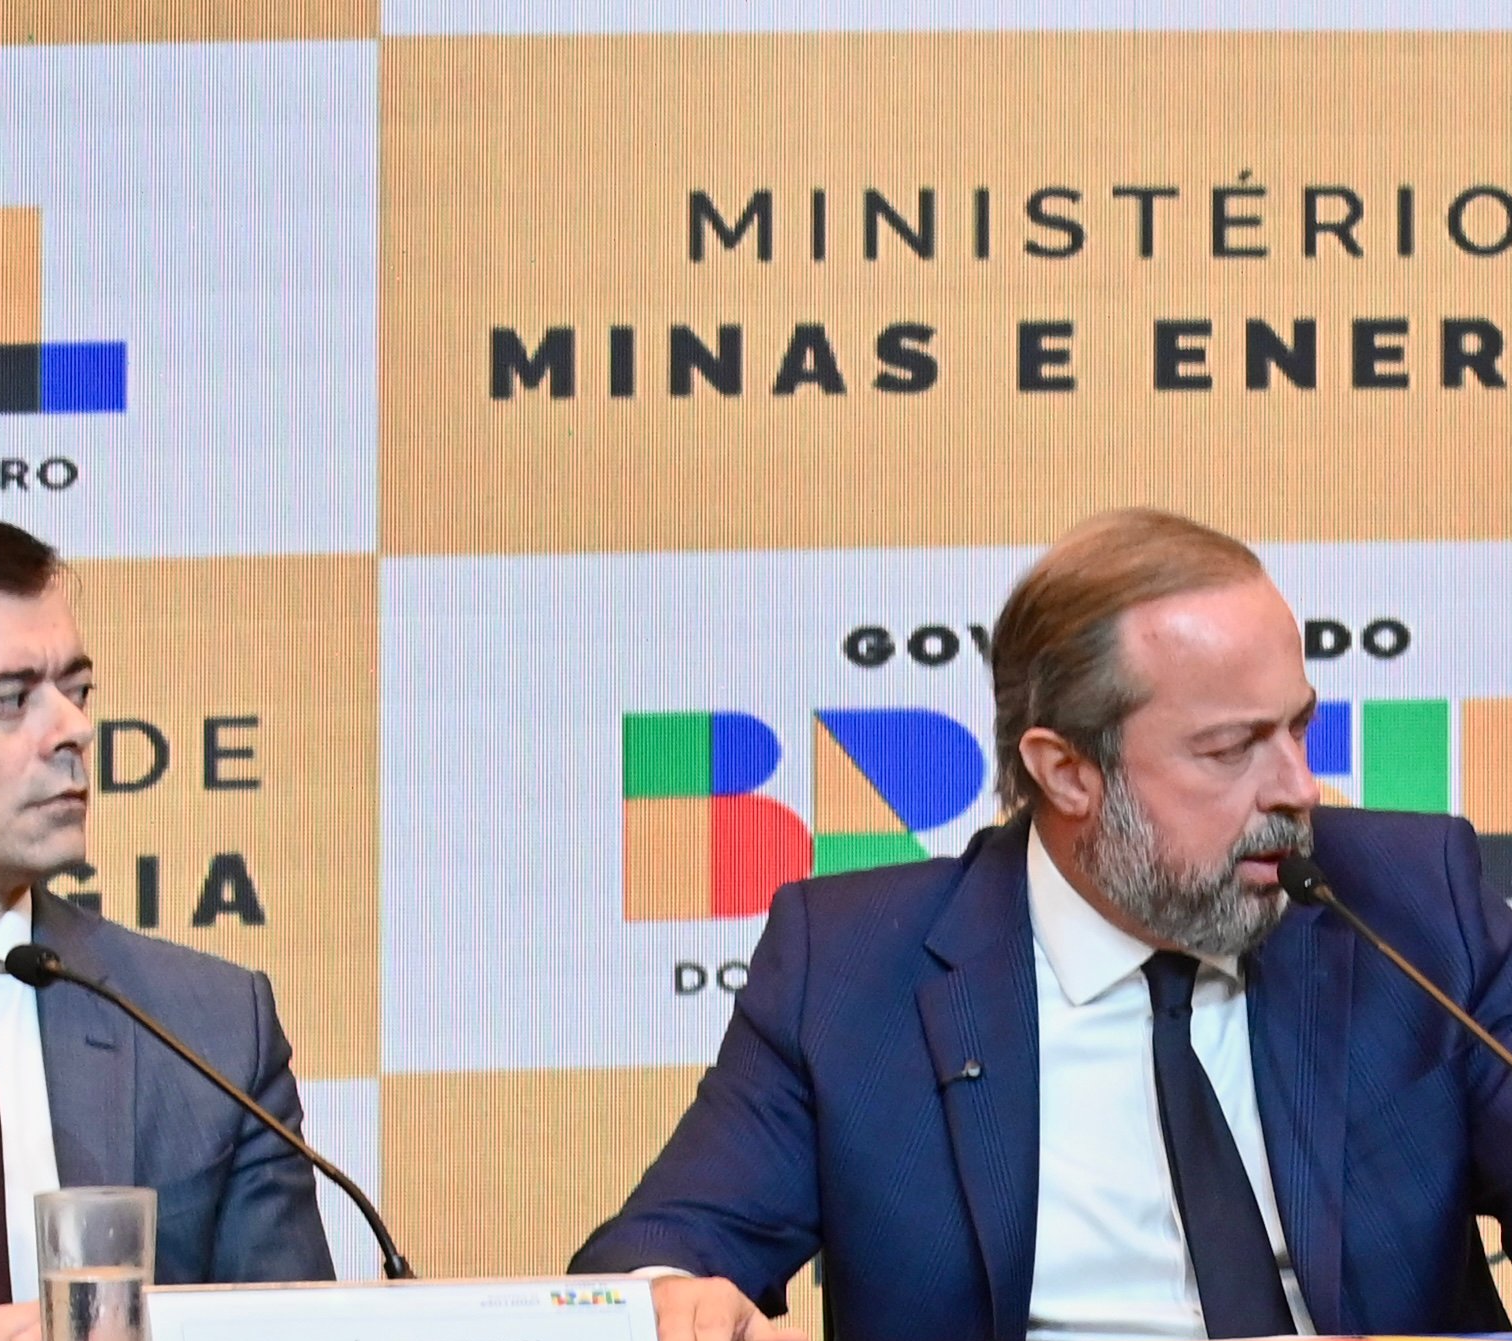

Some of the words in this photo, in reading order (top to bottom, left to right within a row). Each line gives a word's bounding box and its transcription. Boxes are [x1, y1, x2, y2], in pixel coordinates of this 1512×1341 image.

[489, 322, 938, 400] MINAS
[1017, 321, 1076, 393] E
[1305, 617, 1412, 662] DO
[98, 716, 261, 794] DE
[674, 961, 752, 995] DO
